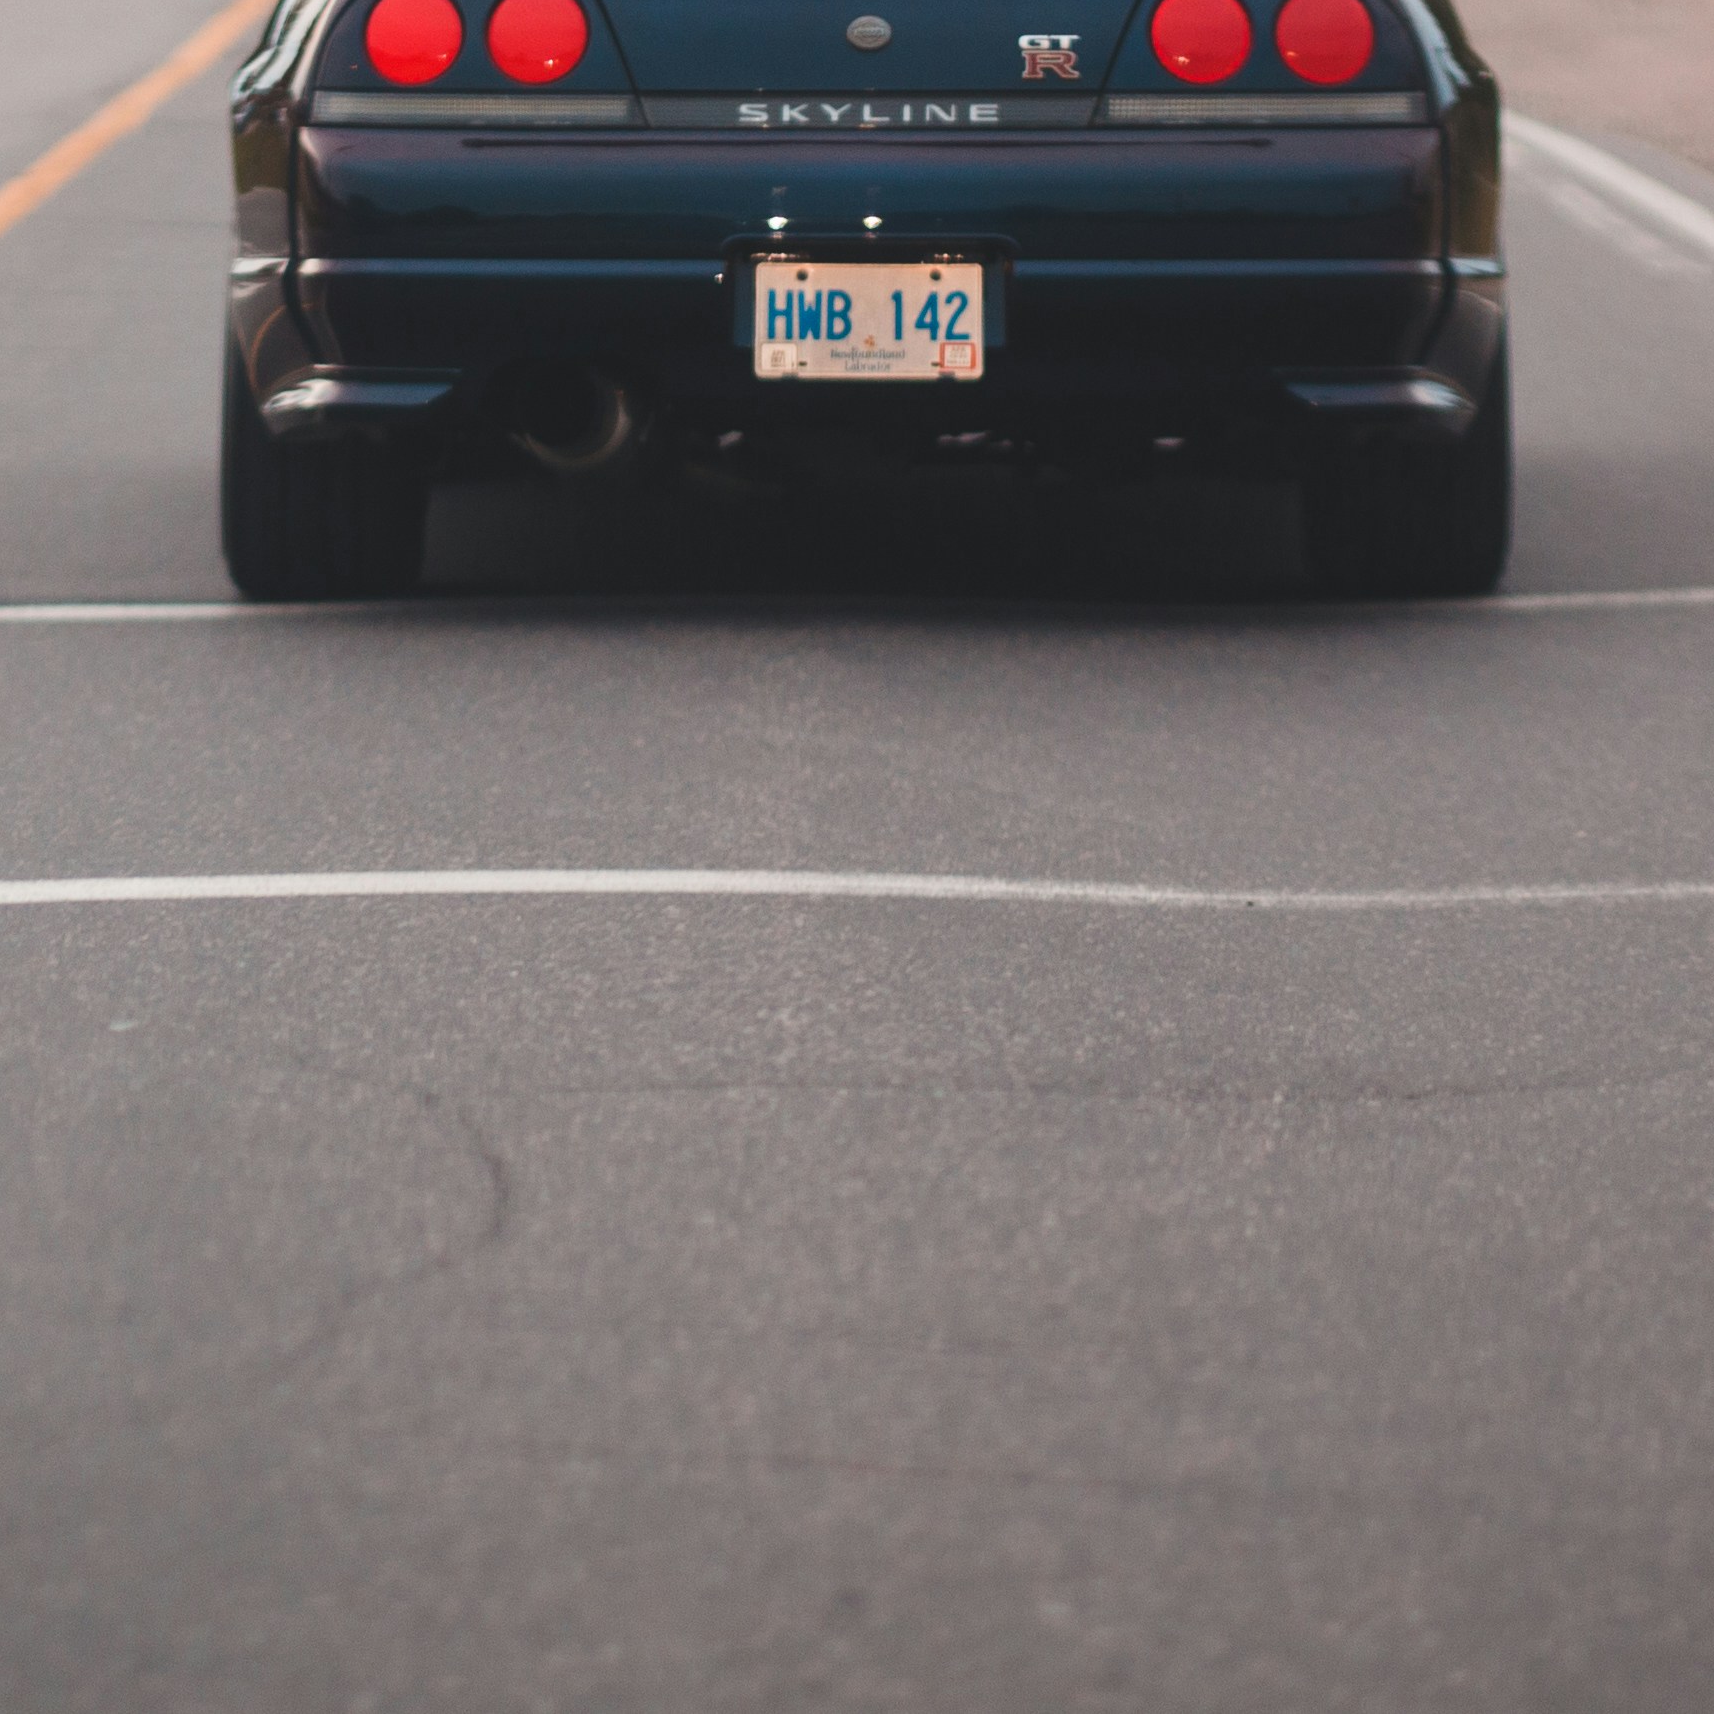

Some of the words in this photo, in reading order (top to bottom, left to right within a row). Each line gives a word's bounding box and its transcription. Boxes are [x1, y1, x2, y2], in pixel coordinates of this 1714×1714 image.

[1018, 34, 1081, 50] GT
[1022, 50, 1081, 79] R
[738, 103, 999, 122] SKYLINE
[766, 288, 853, 341] HWB
[891, 289, 971, 341] 142
